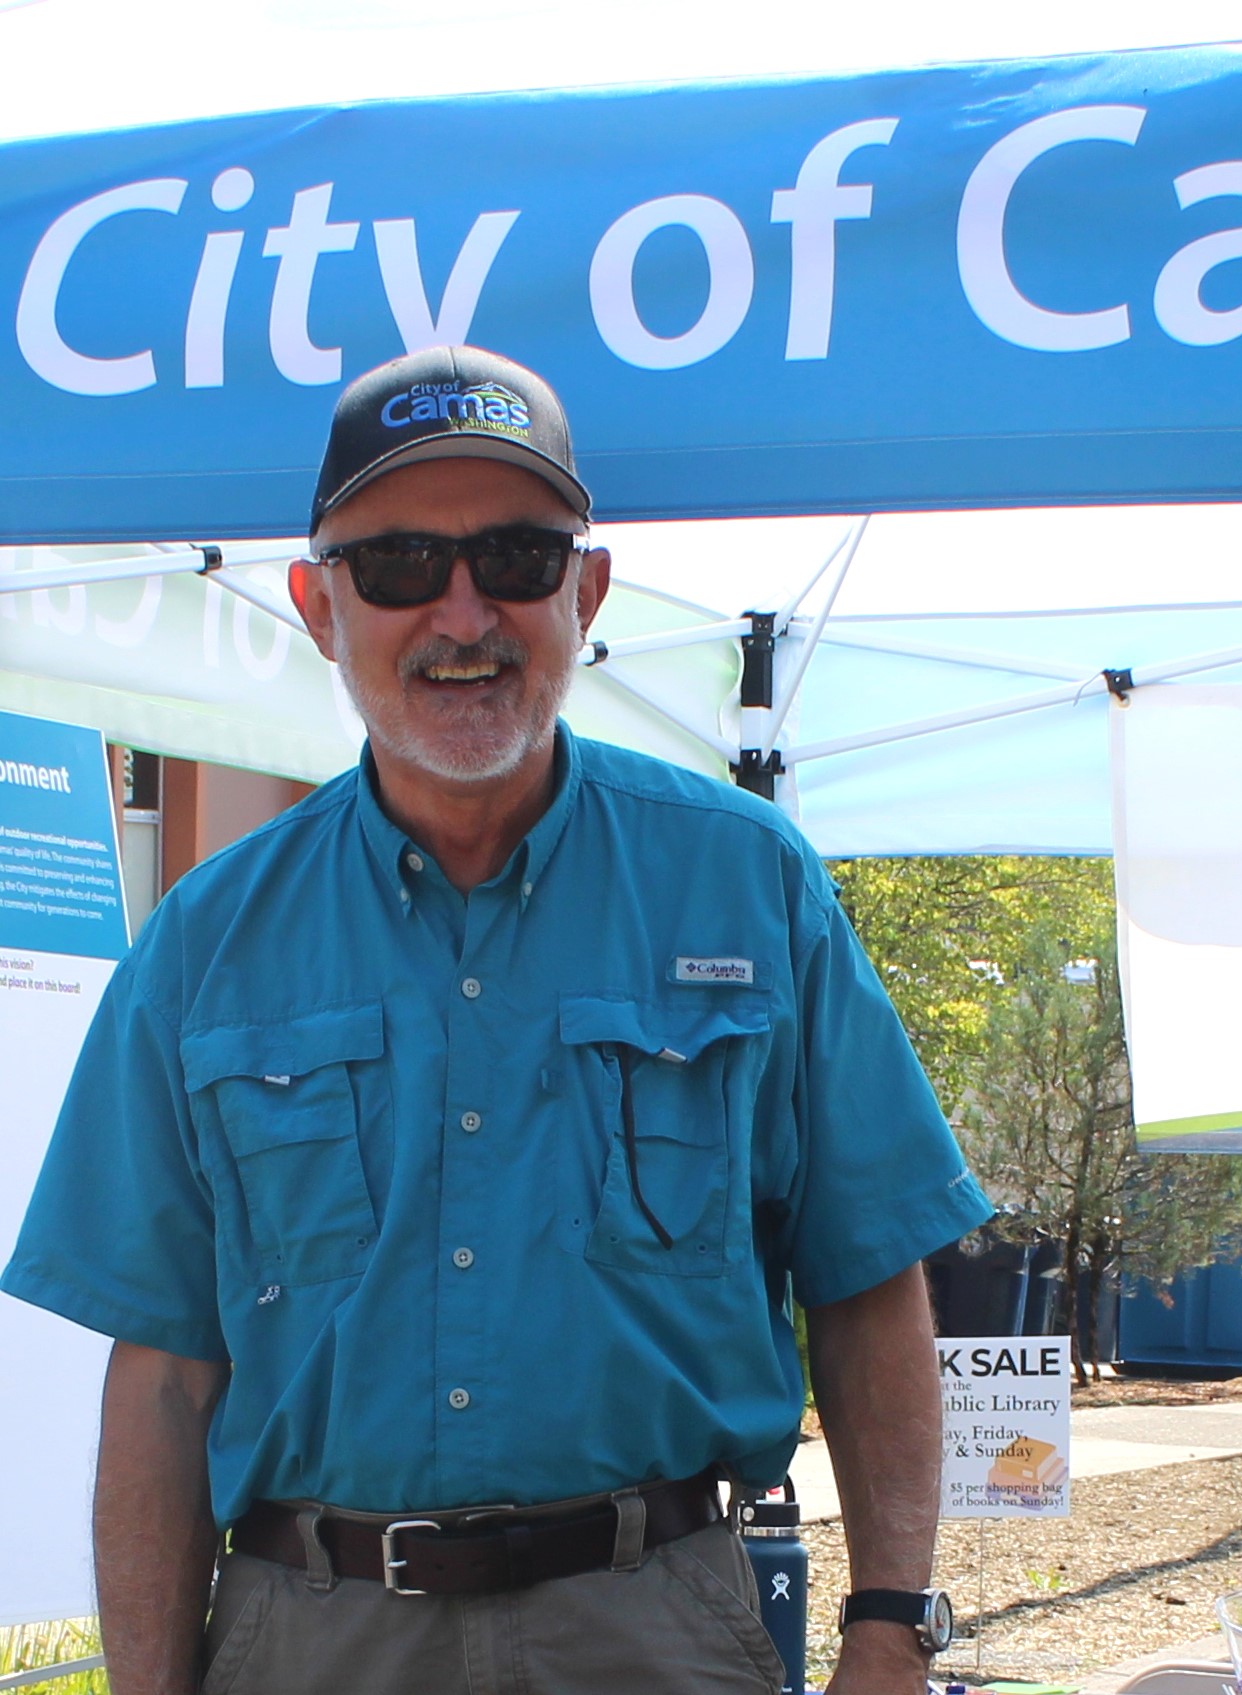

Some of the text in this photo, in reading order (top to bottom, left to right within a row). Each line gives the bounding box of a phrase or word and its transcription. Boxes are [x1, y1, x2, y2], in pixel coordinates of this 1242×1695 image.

[16, 167, 522, 397] City
[589, 117, 900, 371] of
[411, 380, 460, 397] City of
[381, 393, 532, 428] Camas
[10, 958, 34, 971] vision?
[8, 976, 27, 990] place
[971, 1348, 1061, 1377] SALE
[953, 1380, 972, 1392] the
[992, 1395, 1061, 1416] Library
[972, 1425, 1028, 1444] Friday,
[956, 1444, 969, 1458] &
[975, 1443, 1034, 1461] Sunday
[951, 1482, 1063, 1496] $5 per shopping bag
[952, 1496, 1064, 1509] of books on Sunday!
